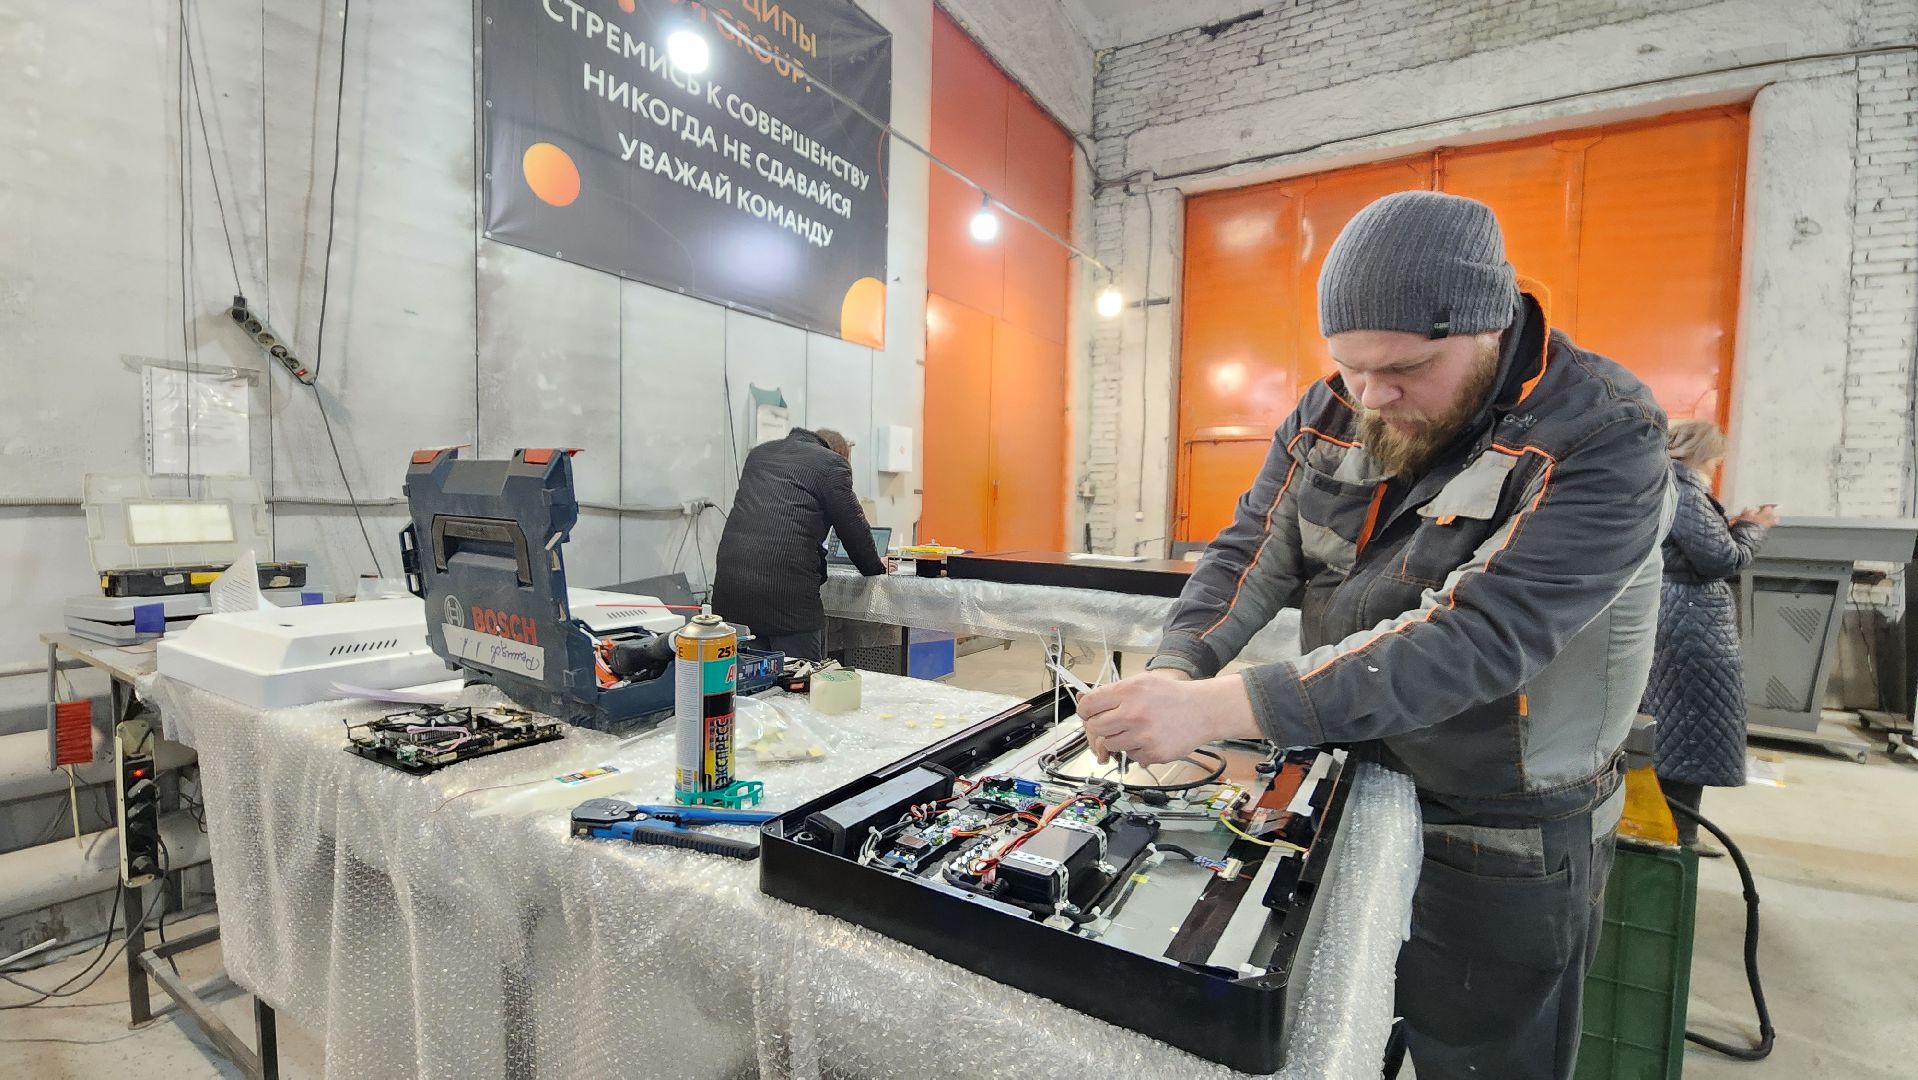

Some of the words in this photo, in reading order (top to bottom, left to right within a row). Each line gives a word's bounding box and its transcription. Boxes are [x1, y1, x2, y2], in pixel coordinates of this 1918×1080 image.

[583, 62, 718, 152] НИКОГДА
[723, 133, 751, 169] НЕ
[756, 152, 851, 219] СДАВАЙСЯ
[618, 131, 731, 204] УВАЖАЙ
[737, 186, 833, 247] КОМАНДУ
[707, 80, 722, 110] К
[726, 94, 869, 191] СОВЕРШЕНСТВУ
[471, 605, 539, 646] BOSCH
[714, 718, 729, 786] ЭКСПРЕСС
